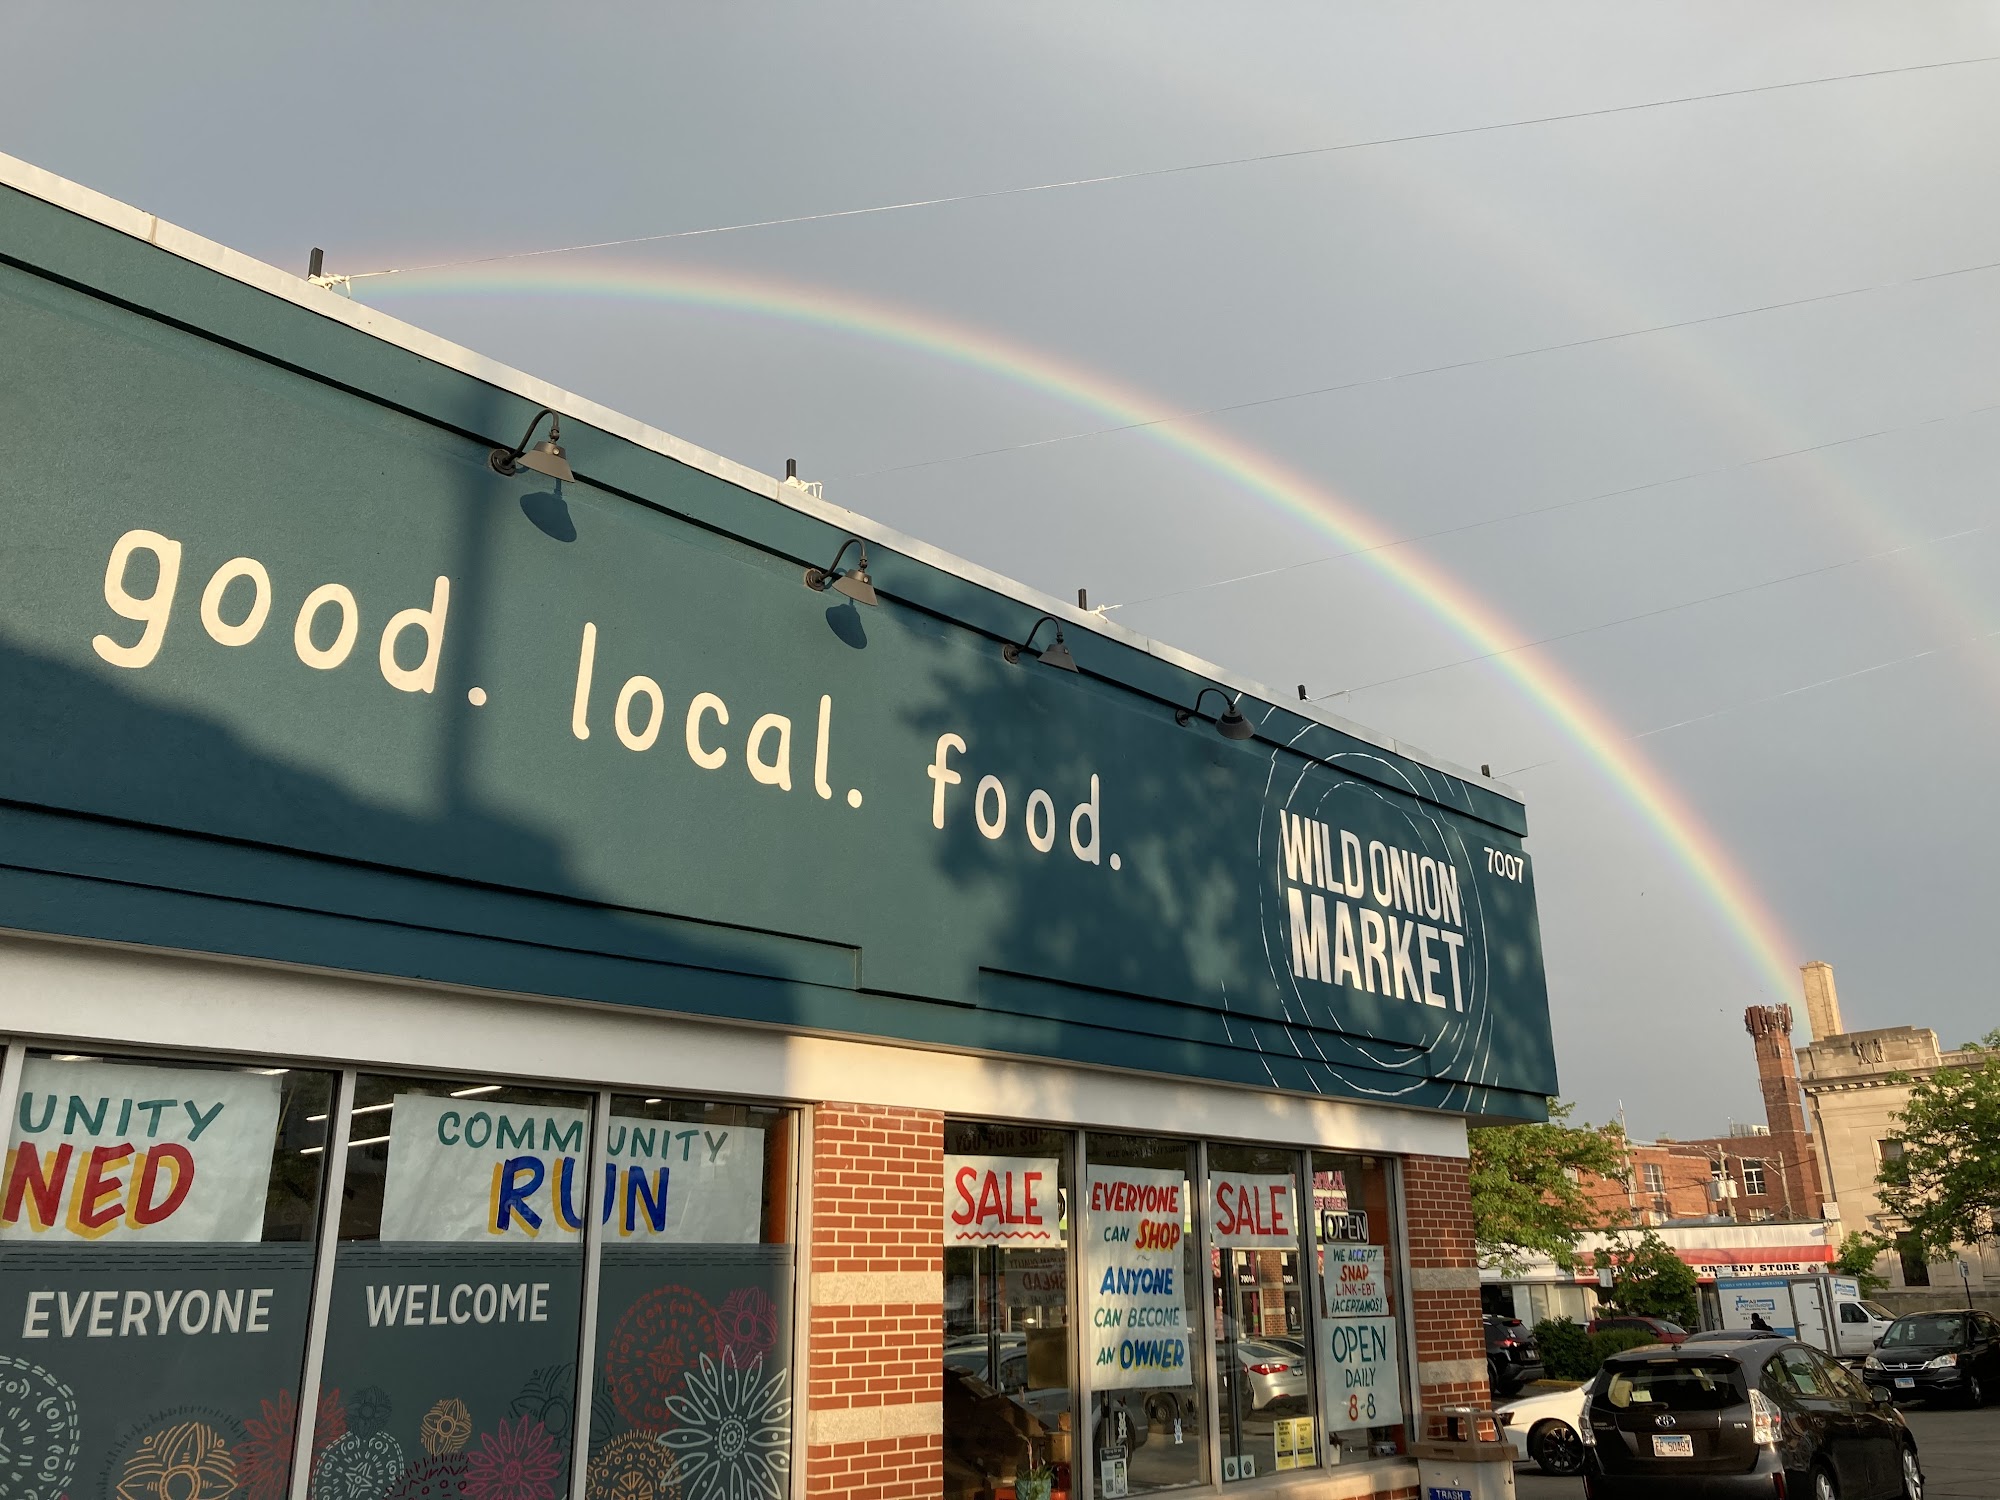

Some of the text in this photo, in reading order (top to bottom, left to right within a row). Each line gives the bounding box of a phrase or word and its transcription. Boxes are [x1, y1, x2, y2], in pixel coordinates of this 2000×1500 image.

[92, 529, 1122, 871] good. local. food.
[1280, 809, 1463, 927] WILD ONION
[1484, 847, 1524, 884] 7007
[1287, 887, 1465, 1013] MARKET
[18, 1092, 225, 1141] UNITY
[0, 1141, 195, 1238] NED
[488, 1156, 669, 1237] RUN
[951, 1166, 1043, 1226] SALE
[1092, 1181, 1179, 1213] EVERYONE
[1216, 1181, 1289, 1235] SALE
[1104, 1218, 1180, 1251] CAN SHOP
[1327, 1214, 1366, 1240] OPEN
[1333, 1249, 1378, 1262] WE ACCEPT
[1760, 1263, 1800, 1272] STORE
[1100, 1266, 1173, 1296] ANYONE
[1336, 1282, 1376, 1296] LINK-EBT
[1340, 1264, 1369, 1282] SNAP
[22, 1283, 550, 1338] EVERYONE WELCOME
[1094, 1307, 1180, 1328] CAN BECOME
[1096, 1338, 1185, 1370] AN OWNER
[1332, 1325, 1386, 1364] OPEN
[1345, 1367, 1377, 1388] DAILY
[1436, 1490, 1463, 1500] TRASH
